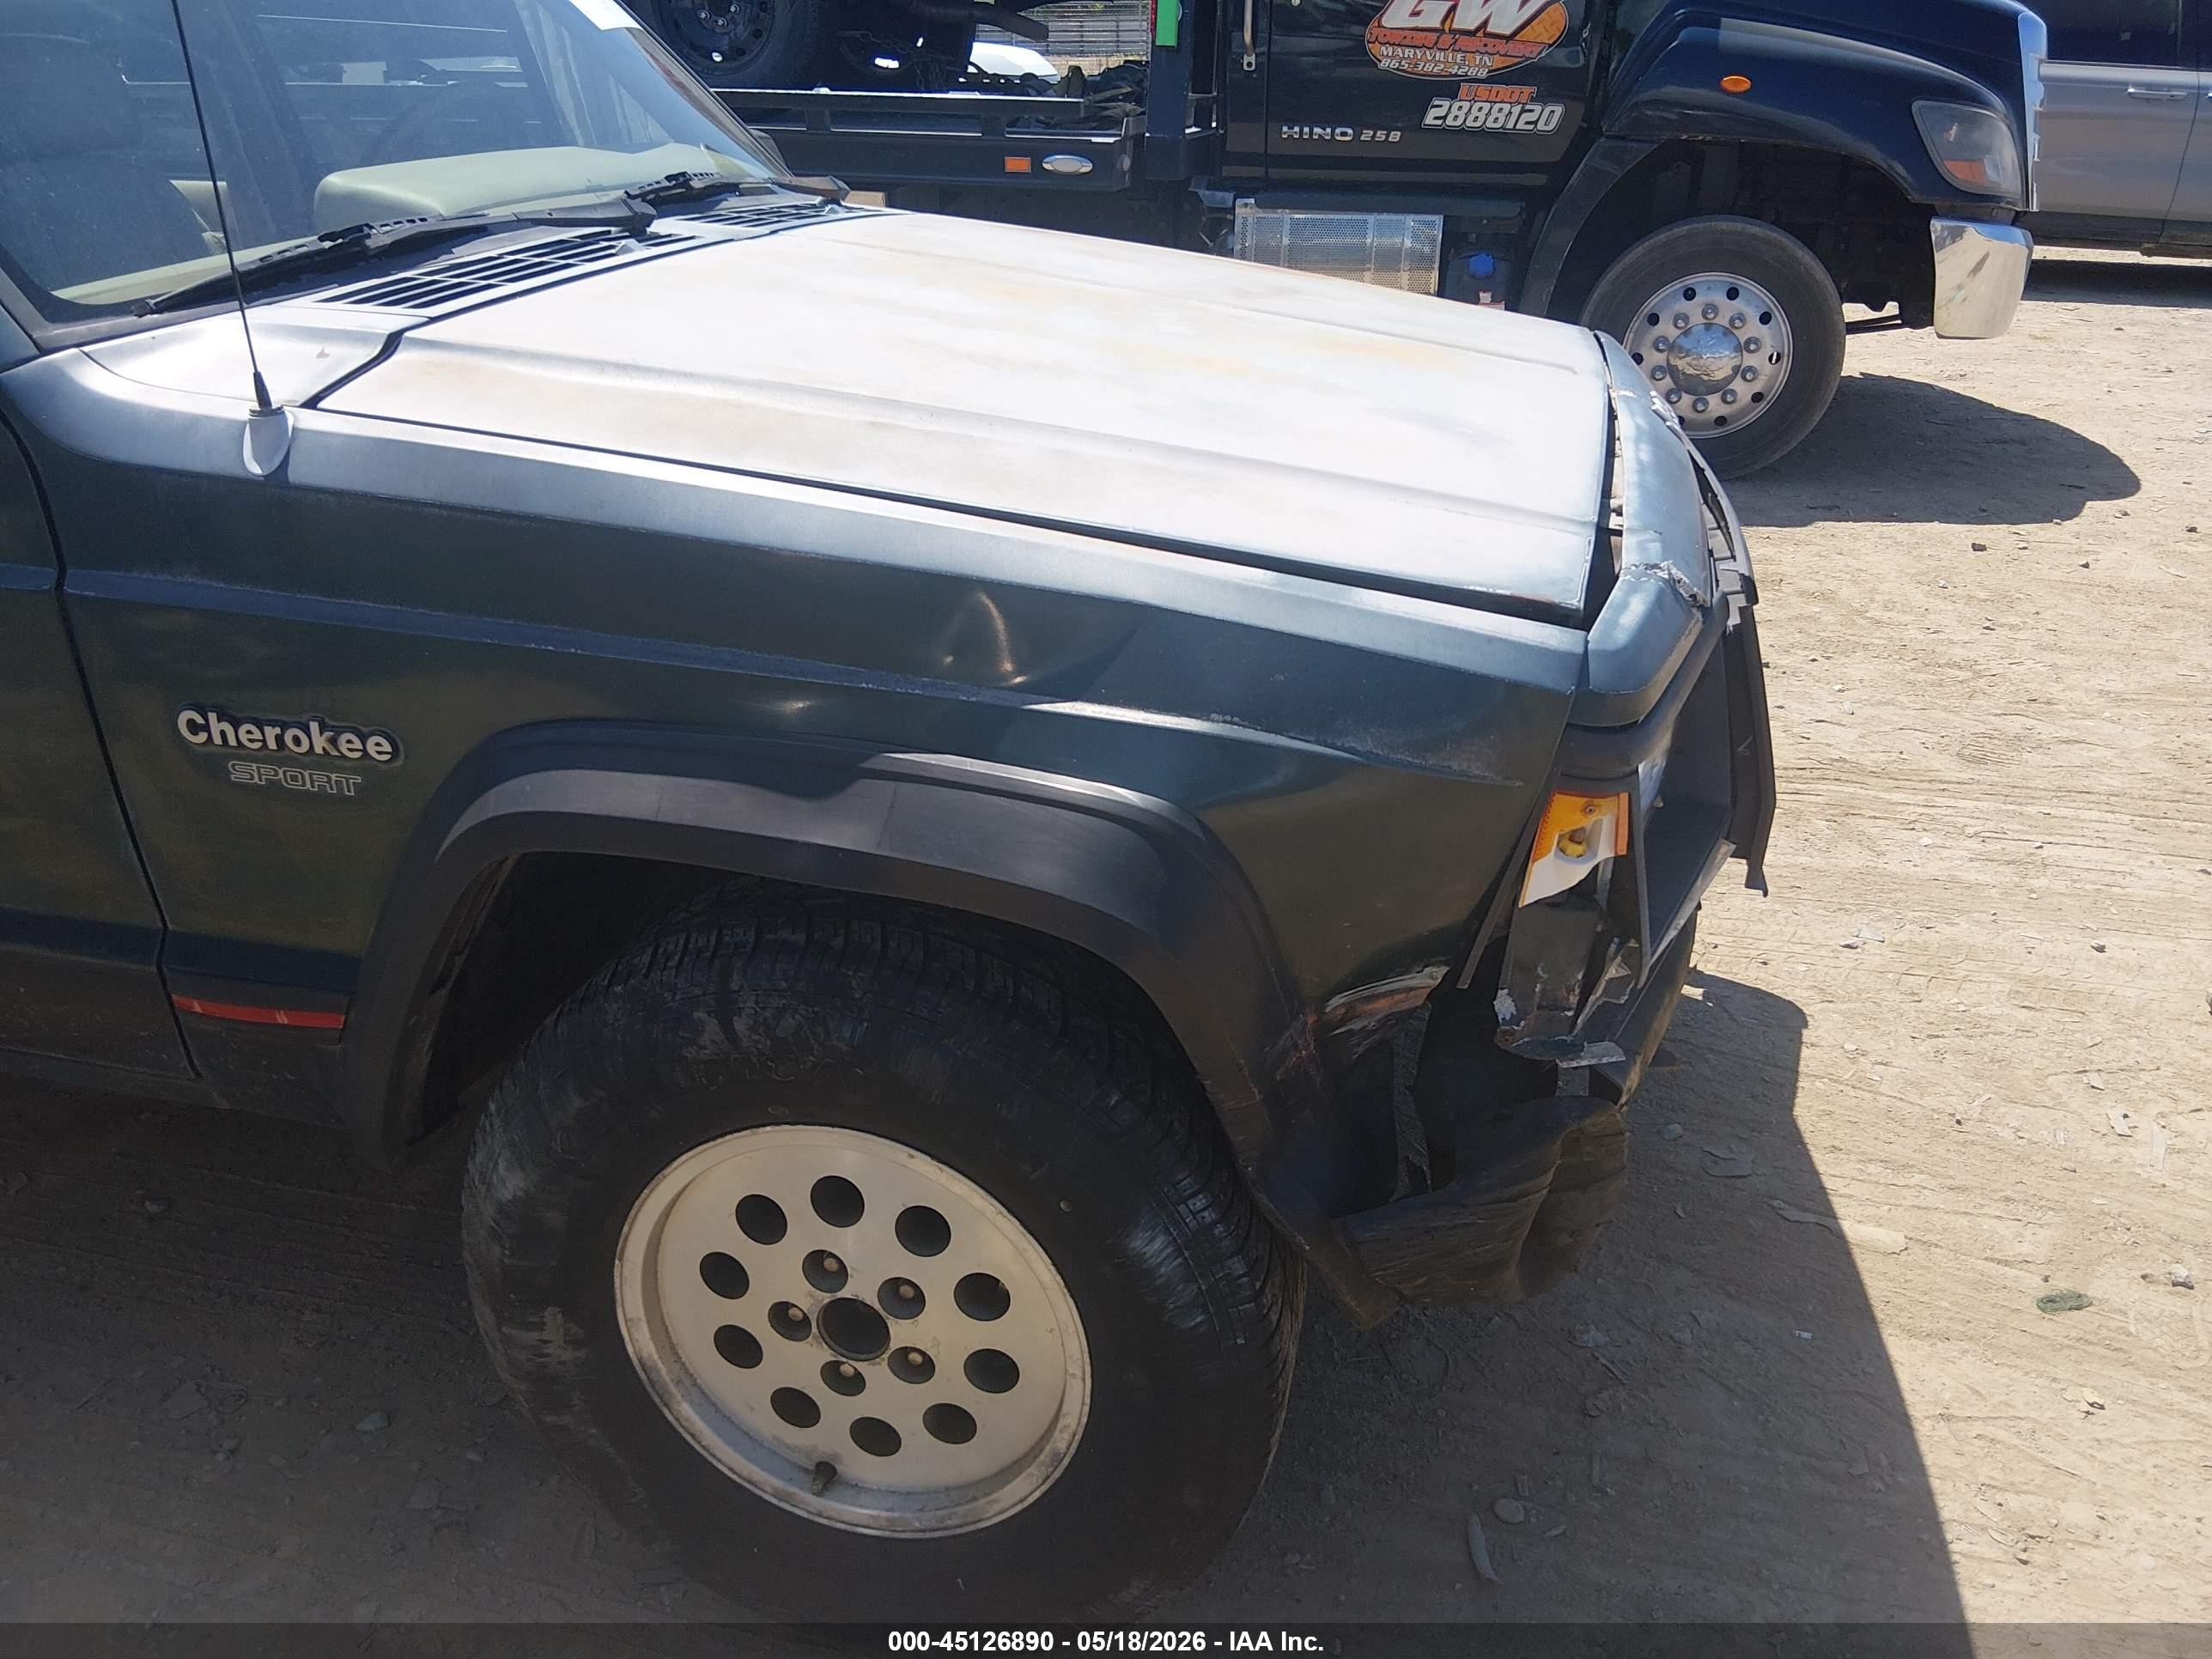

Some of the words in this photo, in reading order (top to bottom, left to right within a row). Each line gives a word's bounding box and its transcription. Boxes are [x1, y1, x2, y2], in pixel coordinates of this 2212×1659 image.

[1379, 46, 1469, 64] MARYVILLE,
[1474, 54, 1494, 67] TN
[1379, 58, 1489, 77] 865-382-4288
[1459, 84, 1535, 104] USDOT
[1424, 98, 1564, 132] 2888120
[1281, 125, 1354, 142] HINO
[1359, 130, 1402, 143] 258
[177, 709, 393, 762] Cherokee
[228, 761, 362, 796] SPORT
